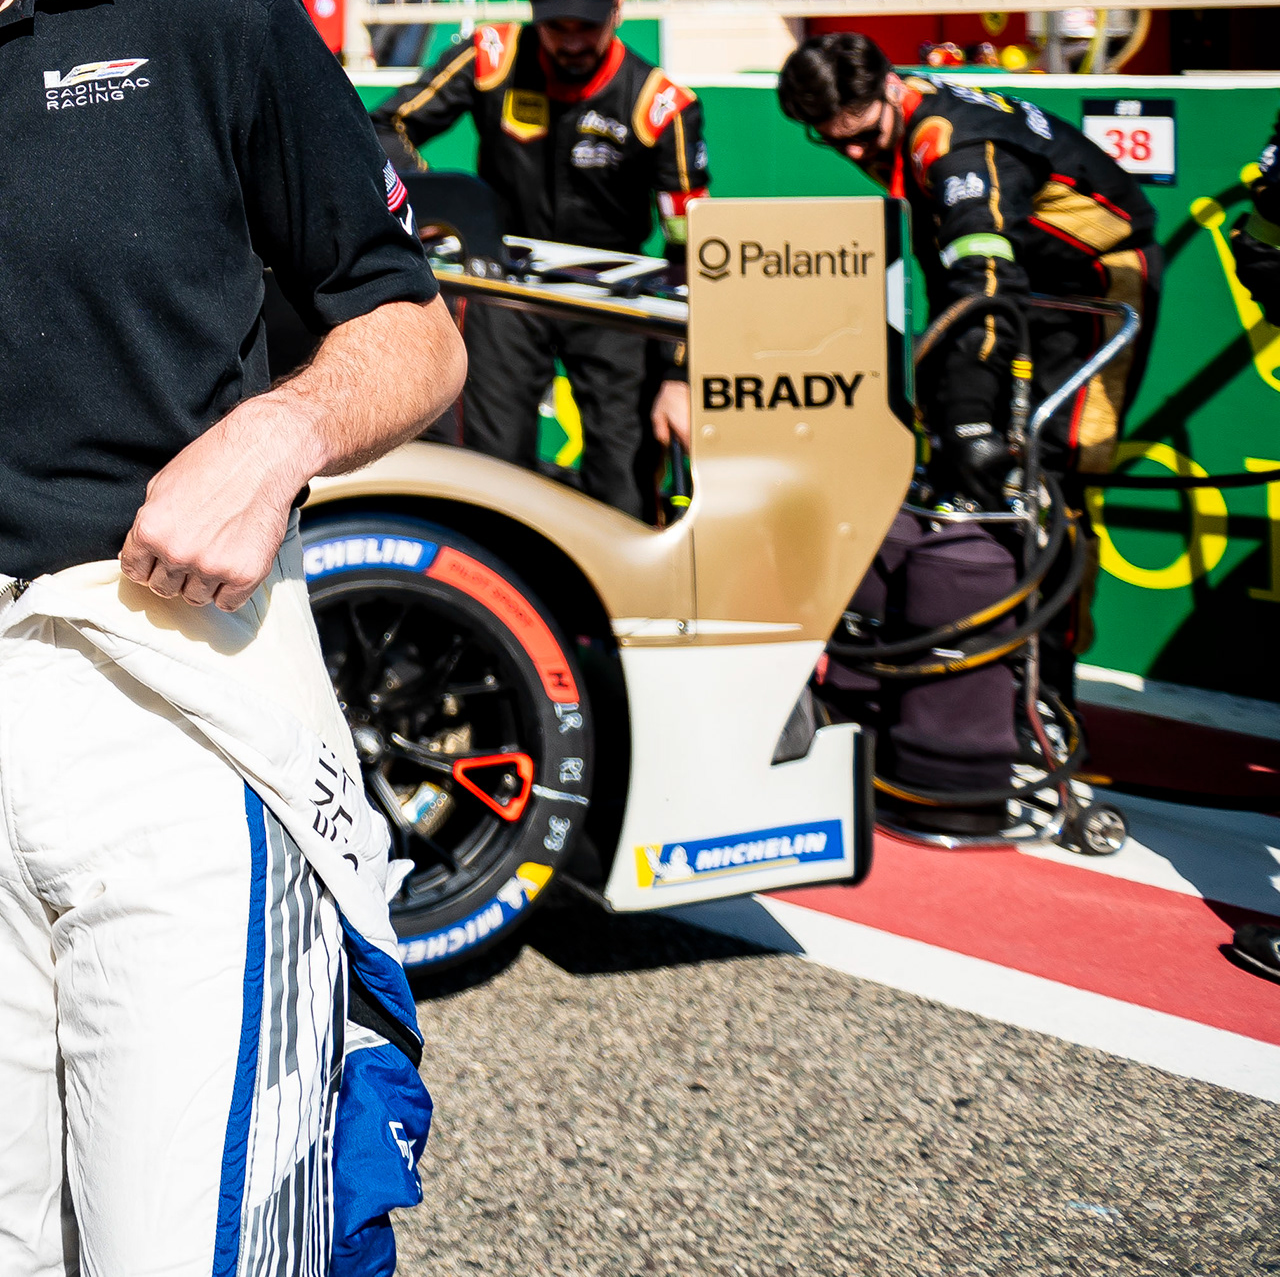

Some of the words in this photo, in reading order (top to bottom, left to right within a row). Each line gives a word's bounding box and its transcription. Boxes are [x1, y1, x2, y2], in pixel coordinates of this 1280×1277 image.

[46, 78, 151, 99] CADILLAC
[47, 91, 125, 110] RACING
[1105, 129, 1153, 162] 38
[740, 240, 875, 278] Palantir
[702, 374, 864, 410] BRADY
[305, 538, 423, 575] CHELIN
[695, 831, 828, 871] MICHELIN
[401, 902, 504, 964] MICHE
